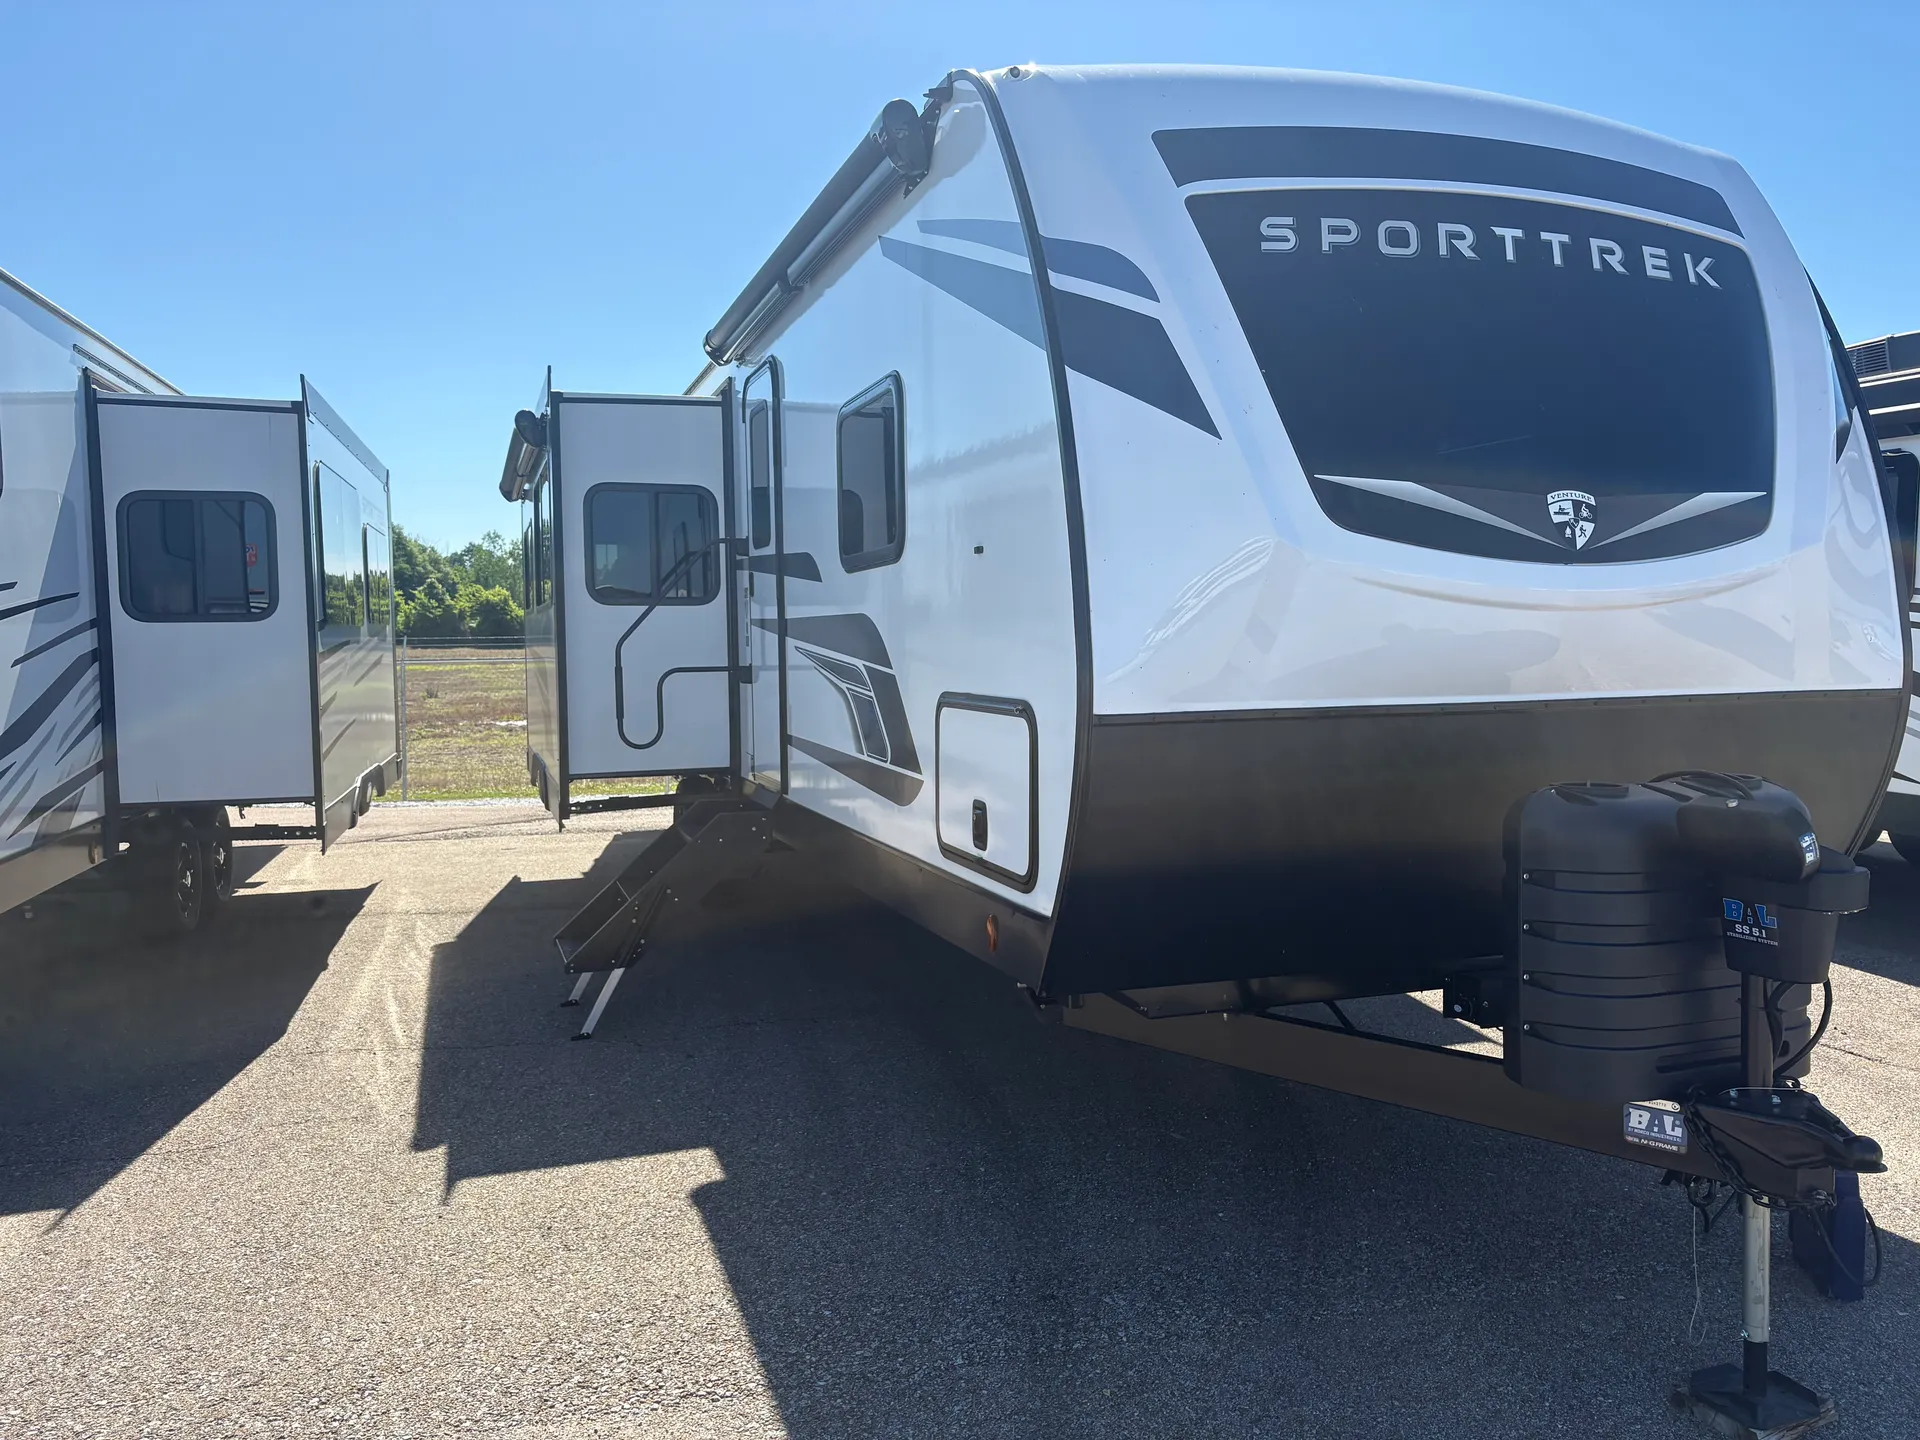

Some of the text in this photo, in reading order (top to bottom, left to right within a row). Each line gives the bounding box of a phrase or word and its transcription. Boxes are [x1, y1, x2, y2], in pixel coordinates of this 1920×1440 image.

[1259, 216, 1722, 289] SPORTTREK
[1550, 493, 1592, 502] VENTURE
[1723, 898, 1777, 928] BAL
[1735, 923, 1750, 934] SS
[1757, 937, 1778, 946] SYSTEM
